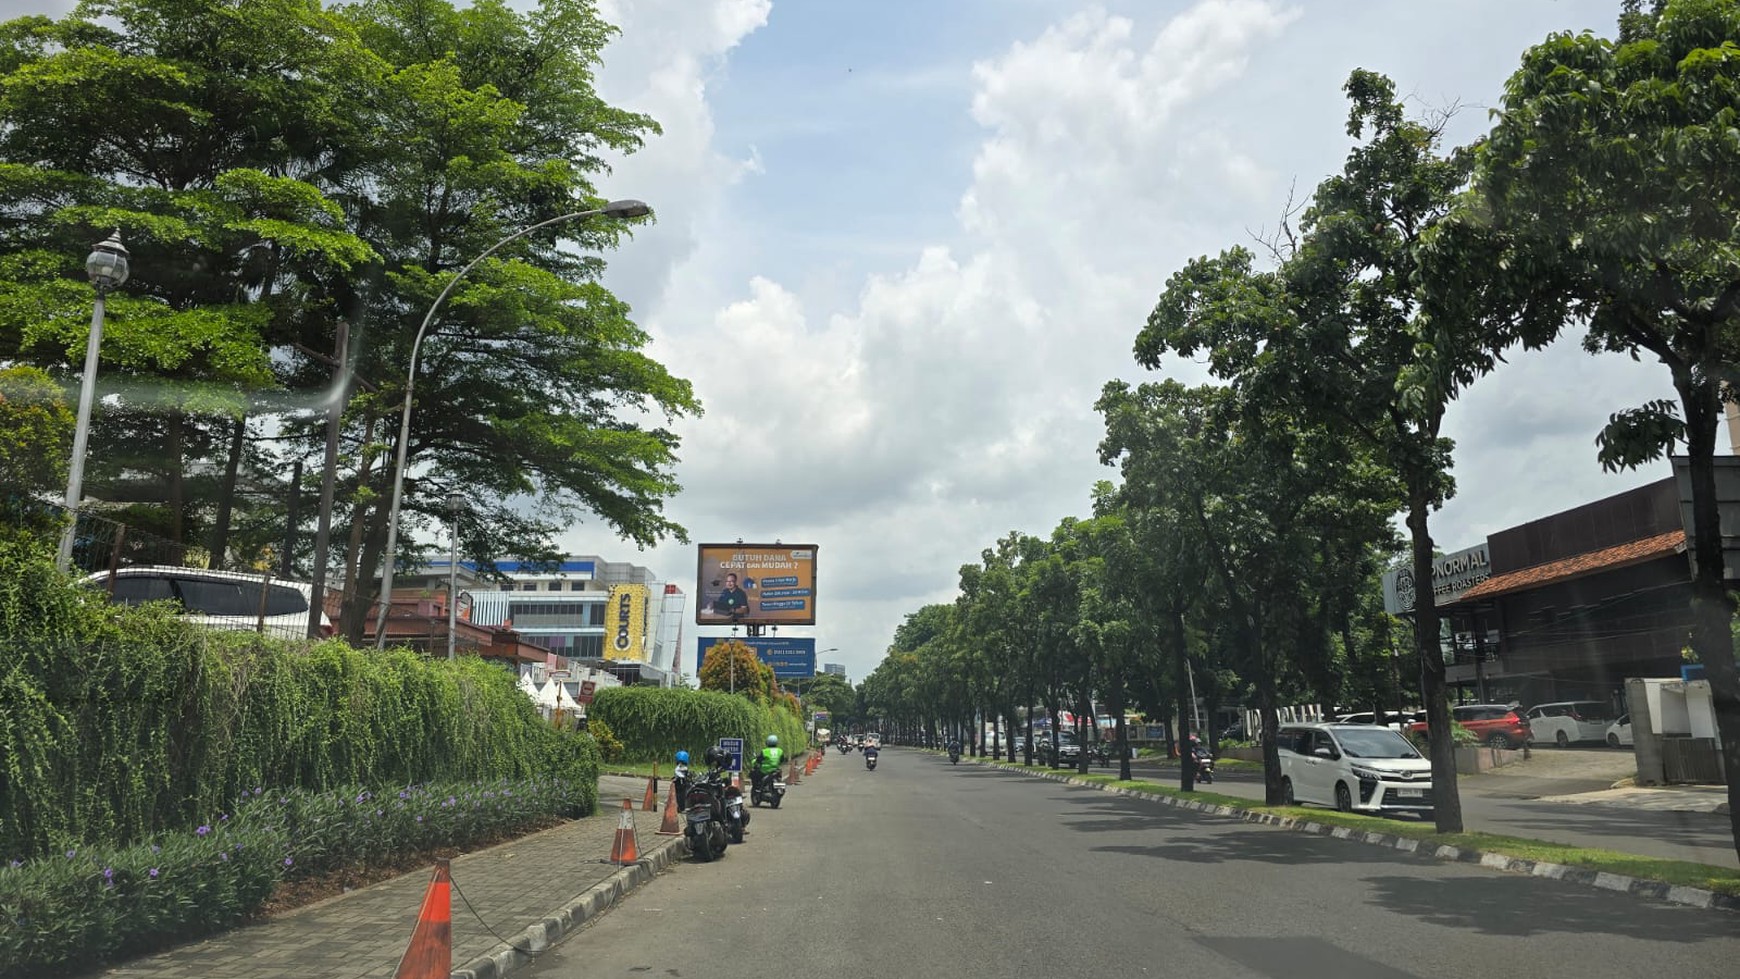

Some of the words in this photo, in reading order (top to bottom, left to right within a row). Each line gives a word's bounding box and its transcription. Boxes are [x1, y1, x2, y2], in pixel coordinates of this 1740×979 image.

[720, 561, 744, 569] CEPAT
[761, 561, 792, 569] MUDAH
[616, 593, 630, 649] COURTS
